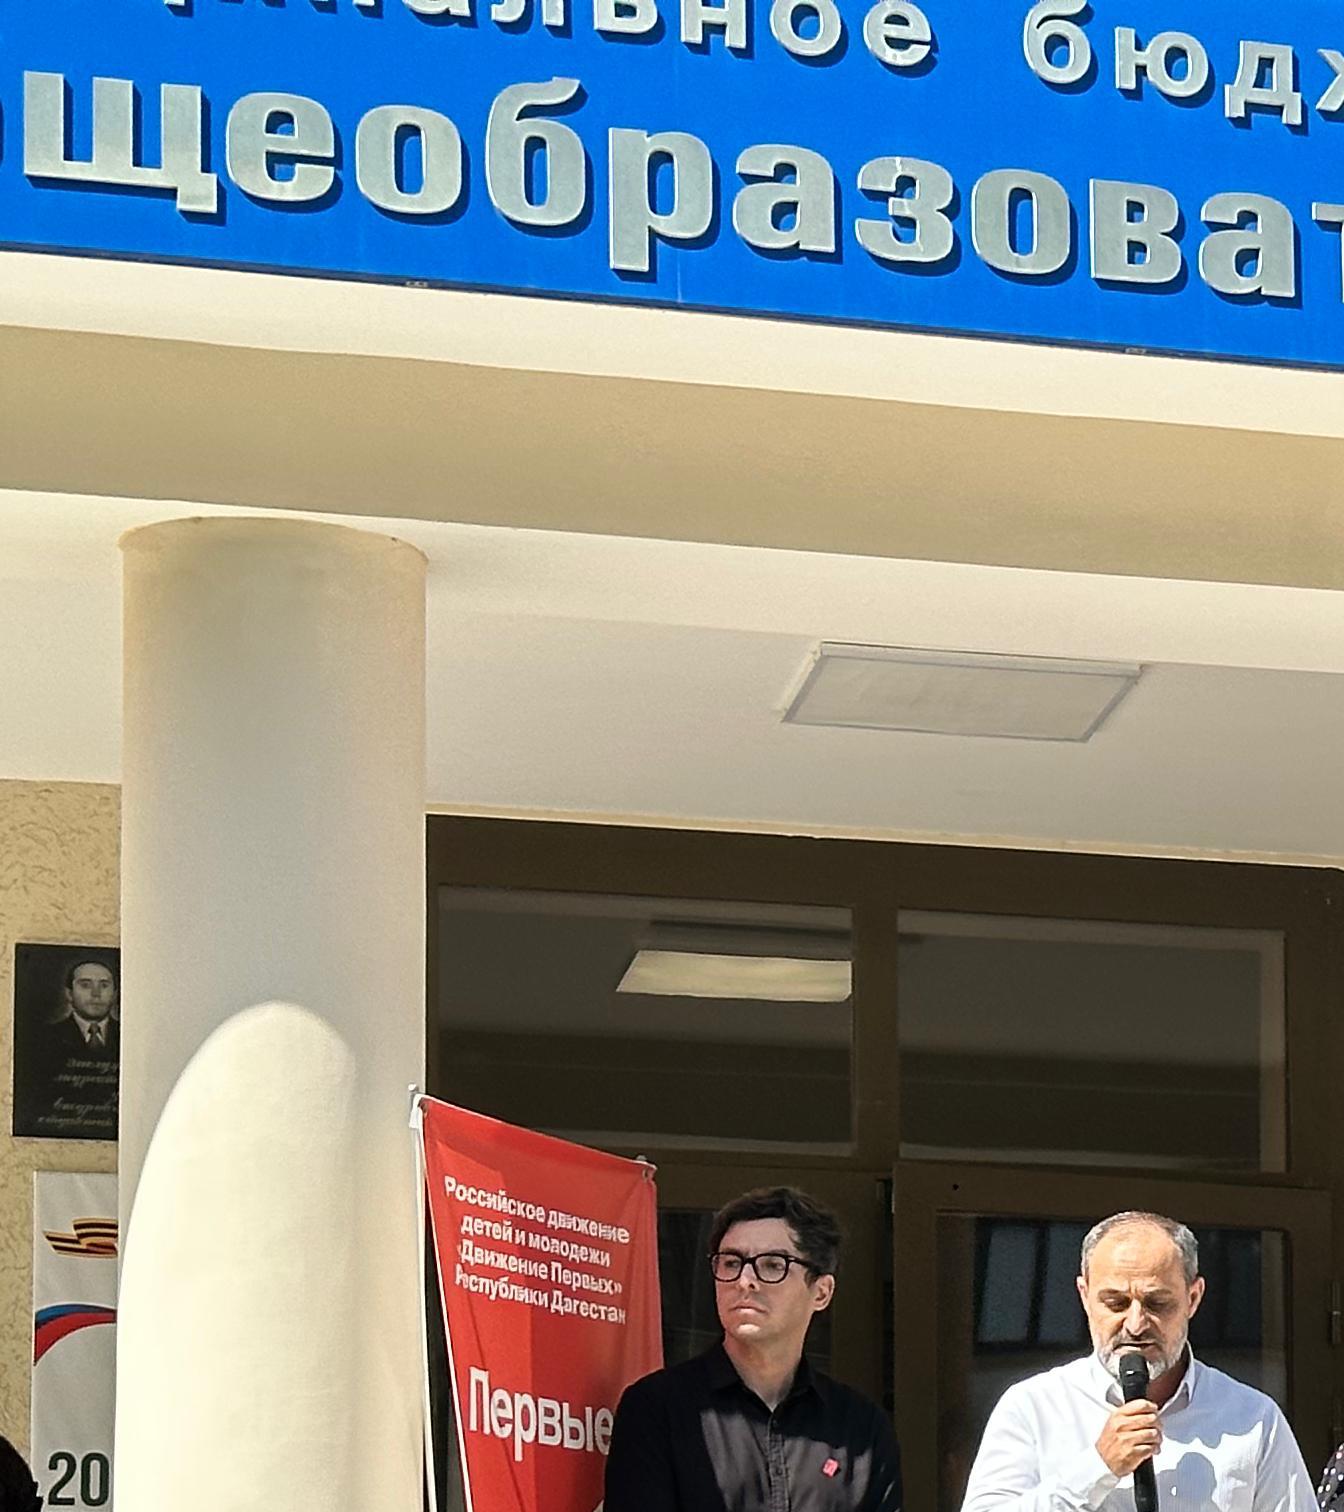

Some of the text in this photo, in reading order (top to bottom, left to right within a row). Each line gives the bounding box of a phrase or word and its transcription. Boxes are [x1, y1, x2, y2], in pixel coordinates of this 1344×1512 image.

[444, 1175, 630, 1243] Российское движение
[461, 1215, 610, 1267] детей и молодежи
[455, 1263, 626, 1325] Республики Дагестан
[468, 1366, 614, 1462] Первые
